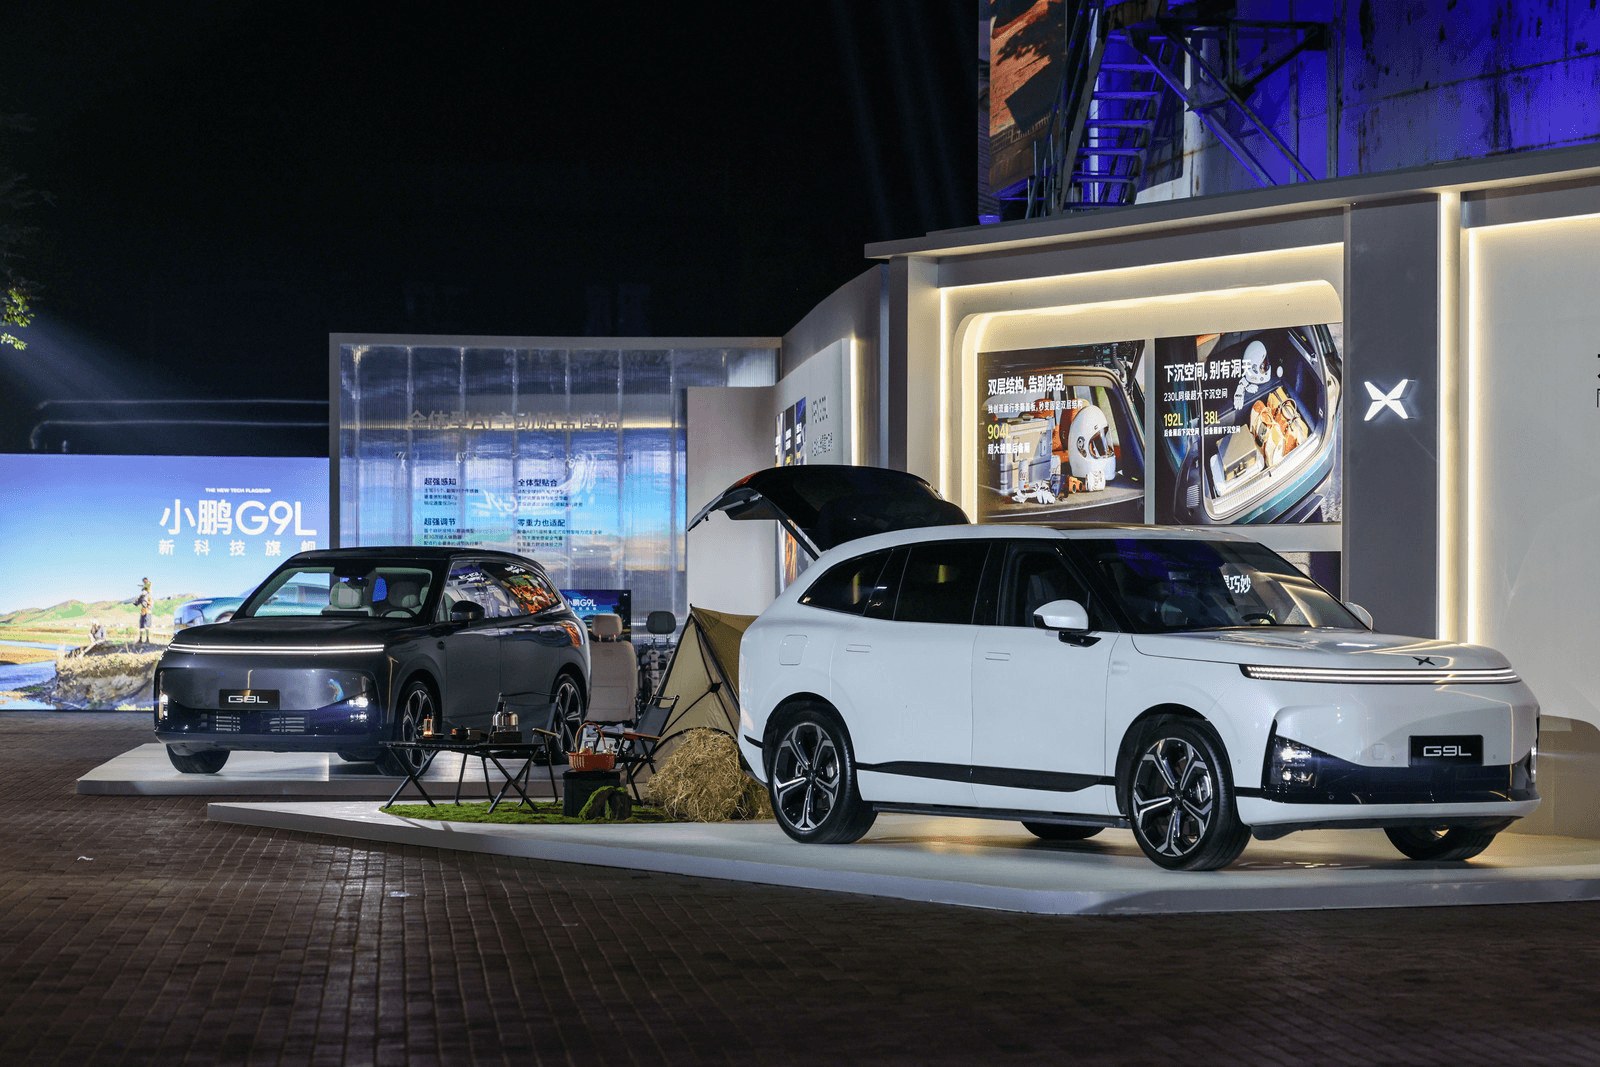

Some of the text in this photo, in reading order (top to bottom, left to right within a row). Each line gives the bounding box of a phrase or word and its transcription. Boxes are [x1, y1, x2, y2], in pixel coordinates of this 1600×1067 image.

[1163, 359, 1253, 383] 下沉空间，别有洞天
[987, 373, 1066, 396] 双层结构，告别杂乱
[1163, 412, 1184, 427] 192L
[1204, 410, 1221, 425] 38L
[987, 422, 1012, 440] 904L
[159, 498, 318, 536] 小鹏G9L
[1423, 745, 1472, 757] G9L
